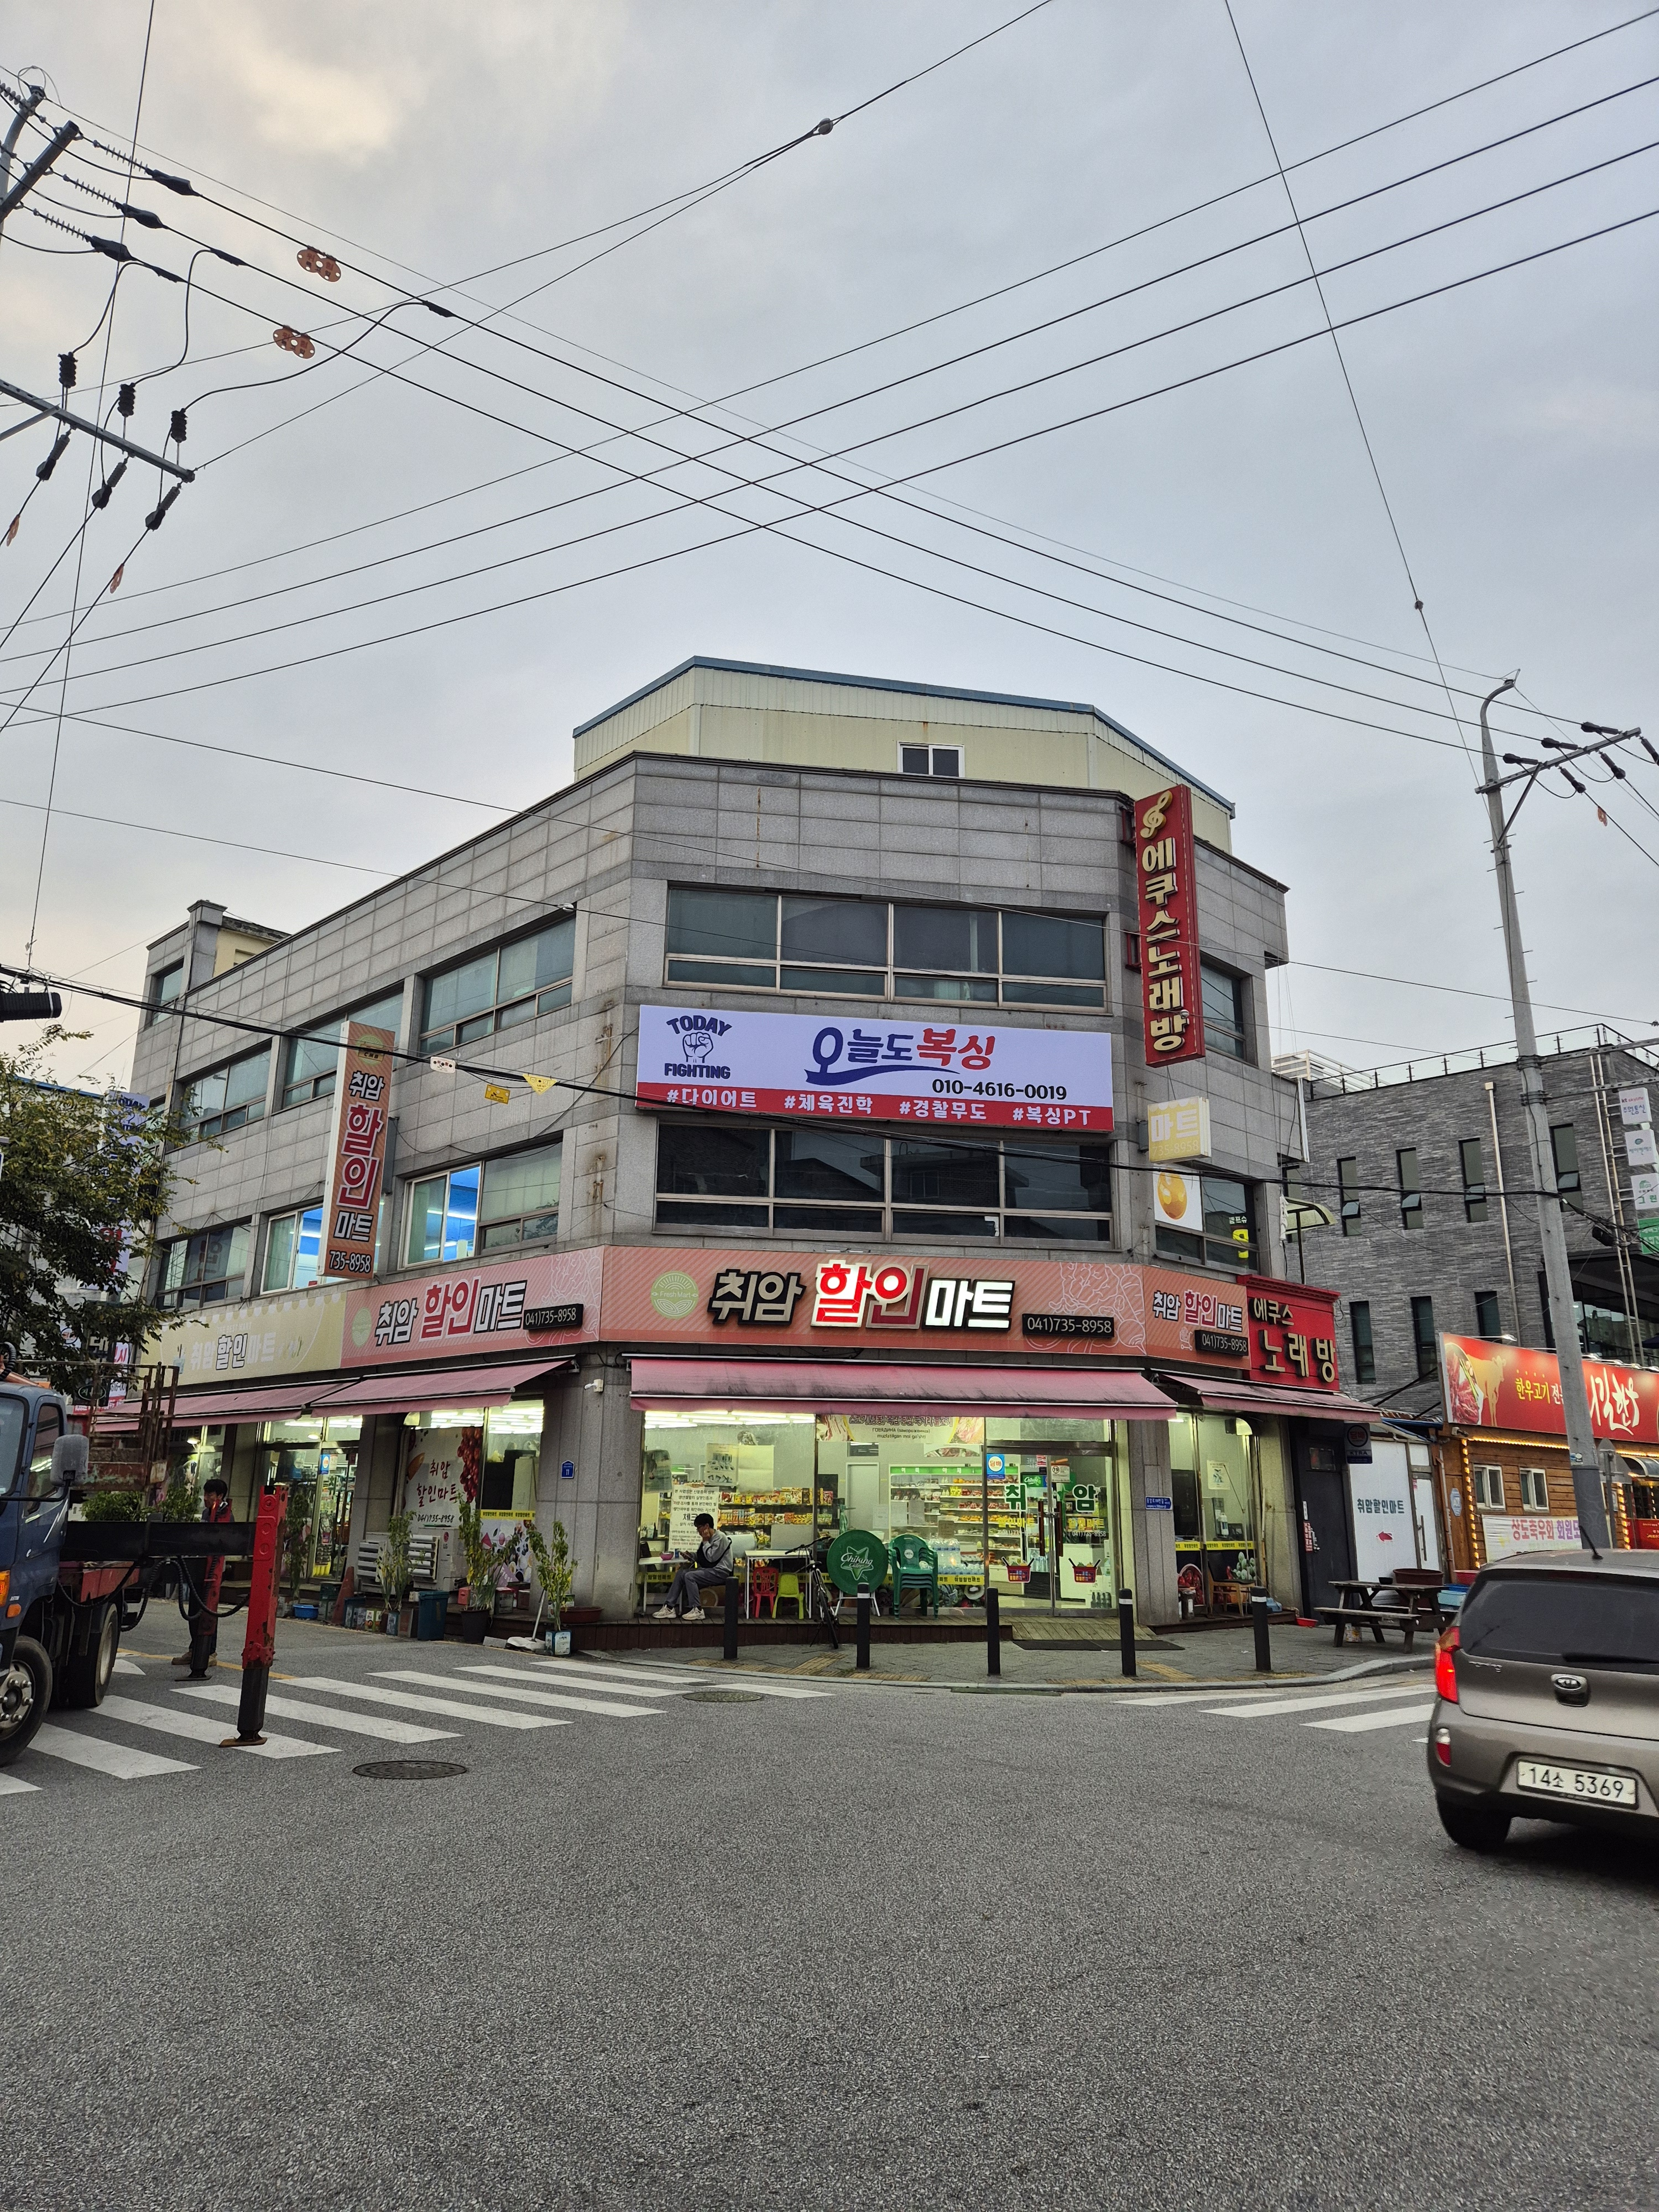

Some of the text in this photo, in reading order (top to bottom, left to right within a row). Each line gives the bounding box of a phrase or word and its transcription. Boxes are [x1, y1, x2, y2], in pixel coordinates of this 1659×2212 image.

[666, 1015, 732, 1036] TODAY
[812, 1027, 995, 1074] 오늘도복싱
[665, 1063, 731, 1079] FIGHTING
[349, 1070, 385, 1100] 취암
[932, 1079, 1067, 1100] 010-4616-0019
[667, 1088, 1091, 1125] #다이어트 #체육진학 #경찰무도 #복싱PT
[1151, 1109, 1199, 1142] 마트
[336, 1102, 383, 1210] 할인
[1152, 1140, 1199, 1156] 735-8958
[333, 1212, 374, 1242] 마트
[329, 1251, 372, 1273] 735-8958
[707, 1268, 807, 1327] 취암
[1152, 1290, 1181, 1322] 취암
[374, 1297, 419, 1347] 취암
[525, 1307, 576, 1326] 041)735-8958
[1253, 1298, 1295, 1327] 에쿠스
[1027, 1317, 1112, 1334] 041)735-8958
[1202, 1333, 1247, 1352] 041)735-8958
[1264, 1329, 1336, 1384] 노래방
[1515, 1378, 1550, 1404] 한우고기
[430, 1459, 451, 1479] 취암
[417, 1483, 458, 1508] 할인마트
[1357, 1498, 1405, 1514] 취암할인마트
[1511, 1519, 1555, 1541] 상도축우회
[841, 1552, 873, 1567] Chilsung
[1529, 1767, 1624, 1798] 14소 5369
